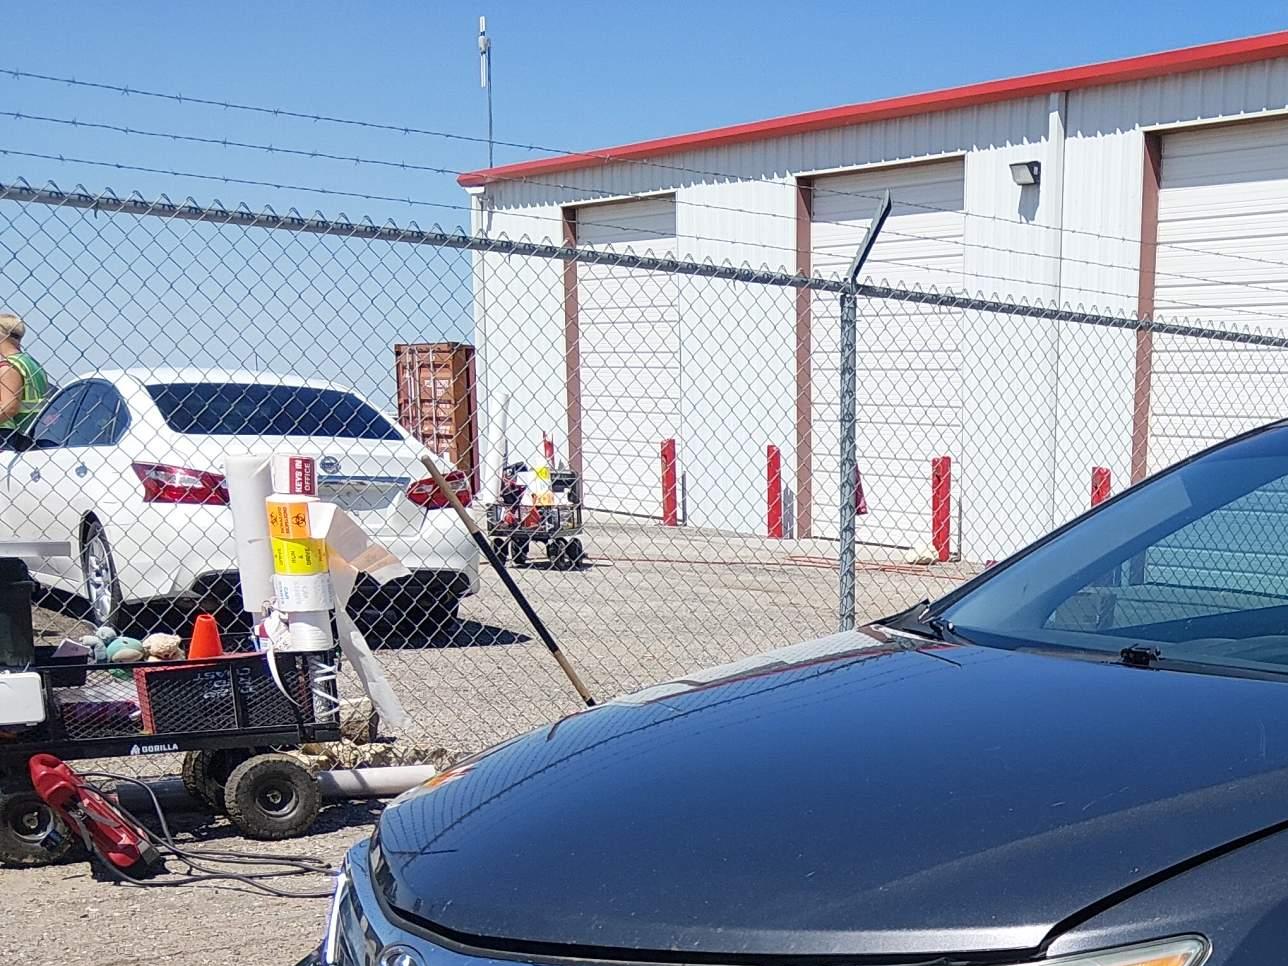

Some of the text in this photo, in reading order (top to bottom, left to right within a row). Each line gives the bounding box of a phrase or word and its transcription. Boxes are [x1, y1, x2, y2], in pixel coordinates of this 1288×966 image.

[294, 459, 303, 493] KEYS IN
[141, 743, 179, 753] GORILLA
